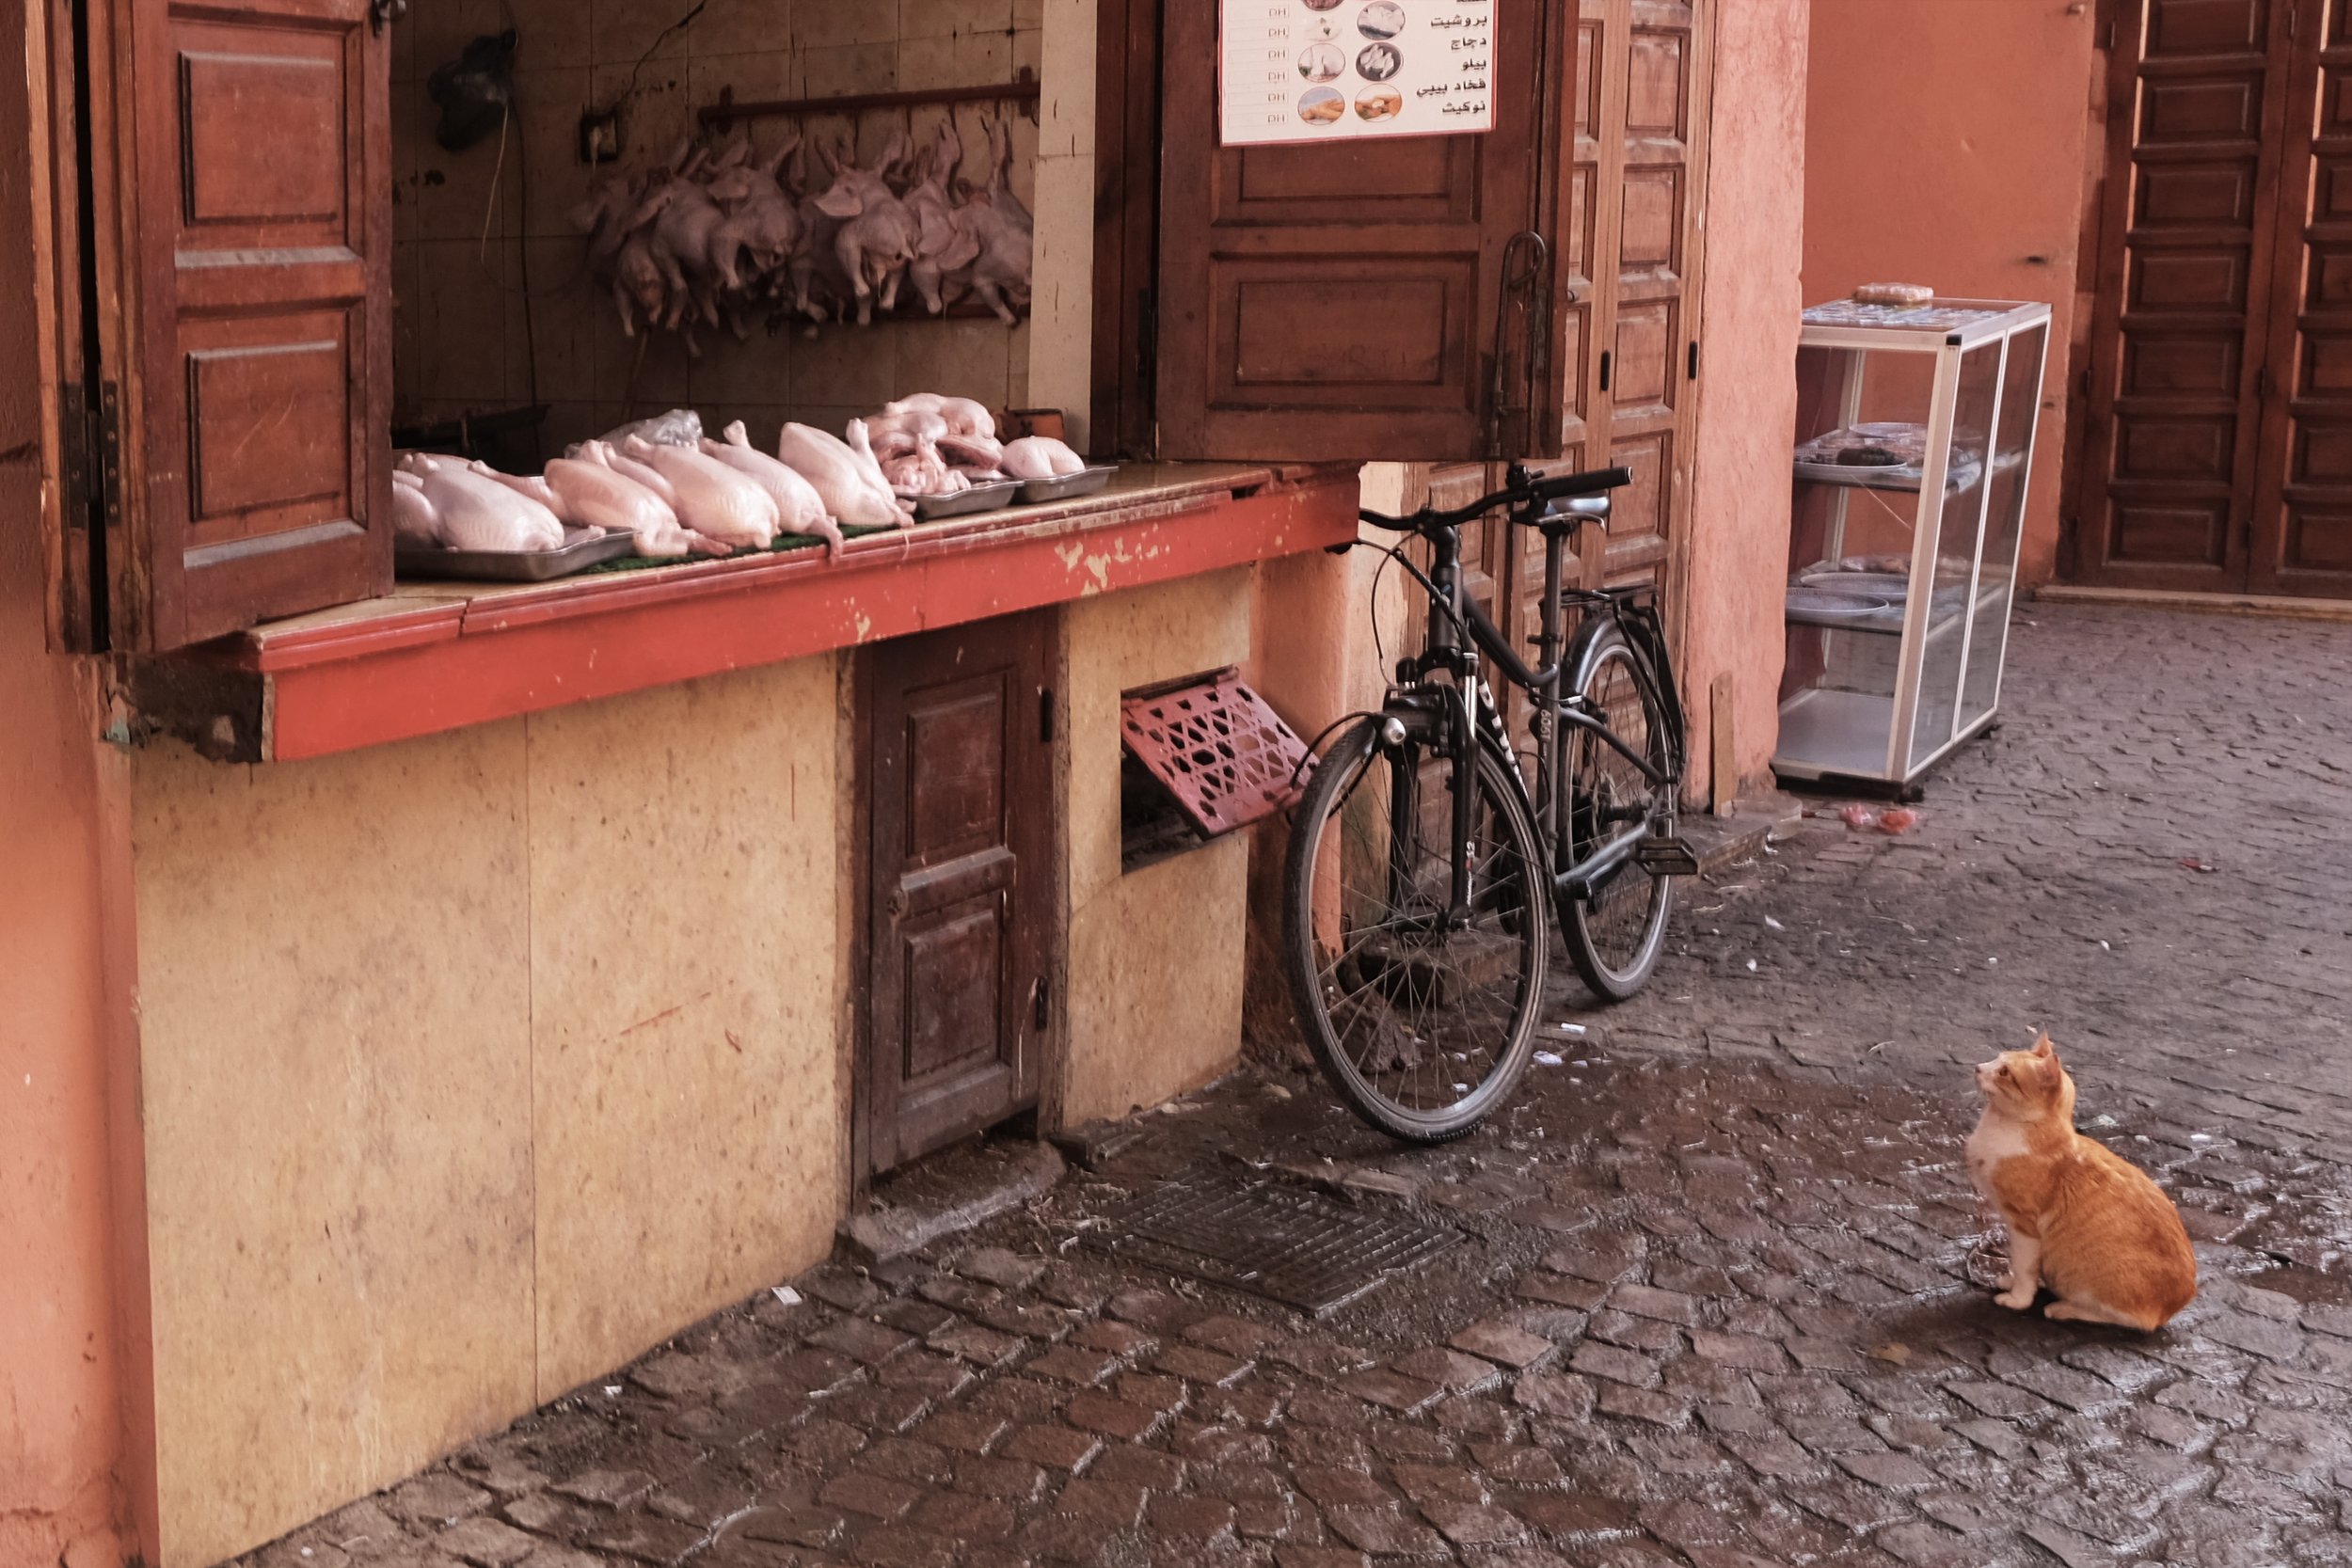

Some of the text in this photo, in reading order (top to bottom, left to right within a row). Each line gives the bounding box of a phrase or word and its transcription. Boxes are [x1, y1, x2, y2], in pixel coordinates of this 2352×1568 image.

[1268, 8, 1286, 17] DH
[1431, 14, 1487, 28] بروشيت
[1268, 27, 1286, 37] DH
[1451, 37, 1486, 50] دجاج
[1268, 50, 1285, 58] DH
[1267, 71, 1285, 81] DH
[1267, 93, 1285, 102] DH
[1267, 114, 1285, 123] DH
